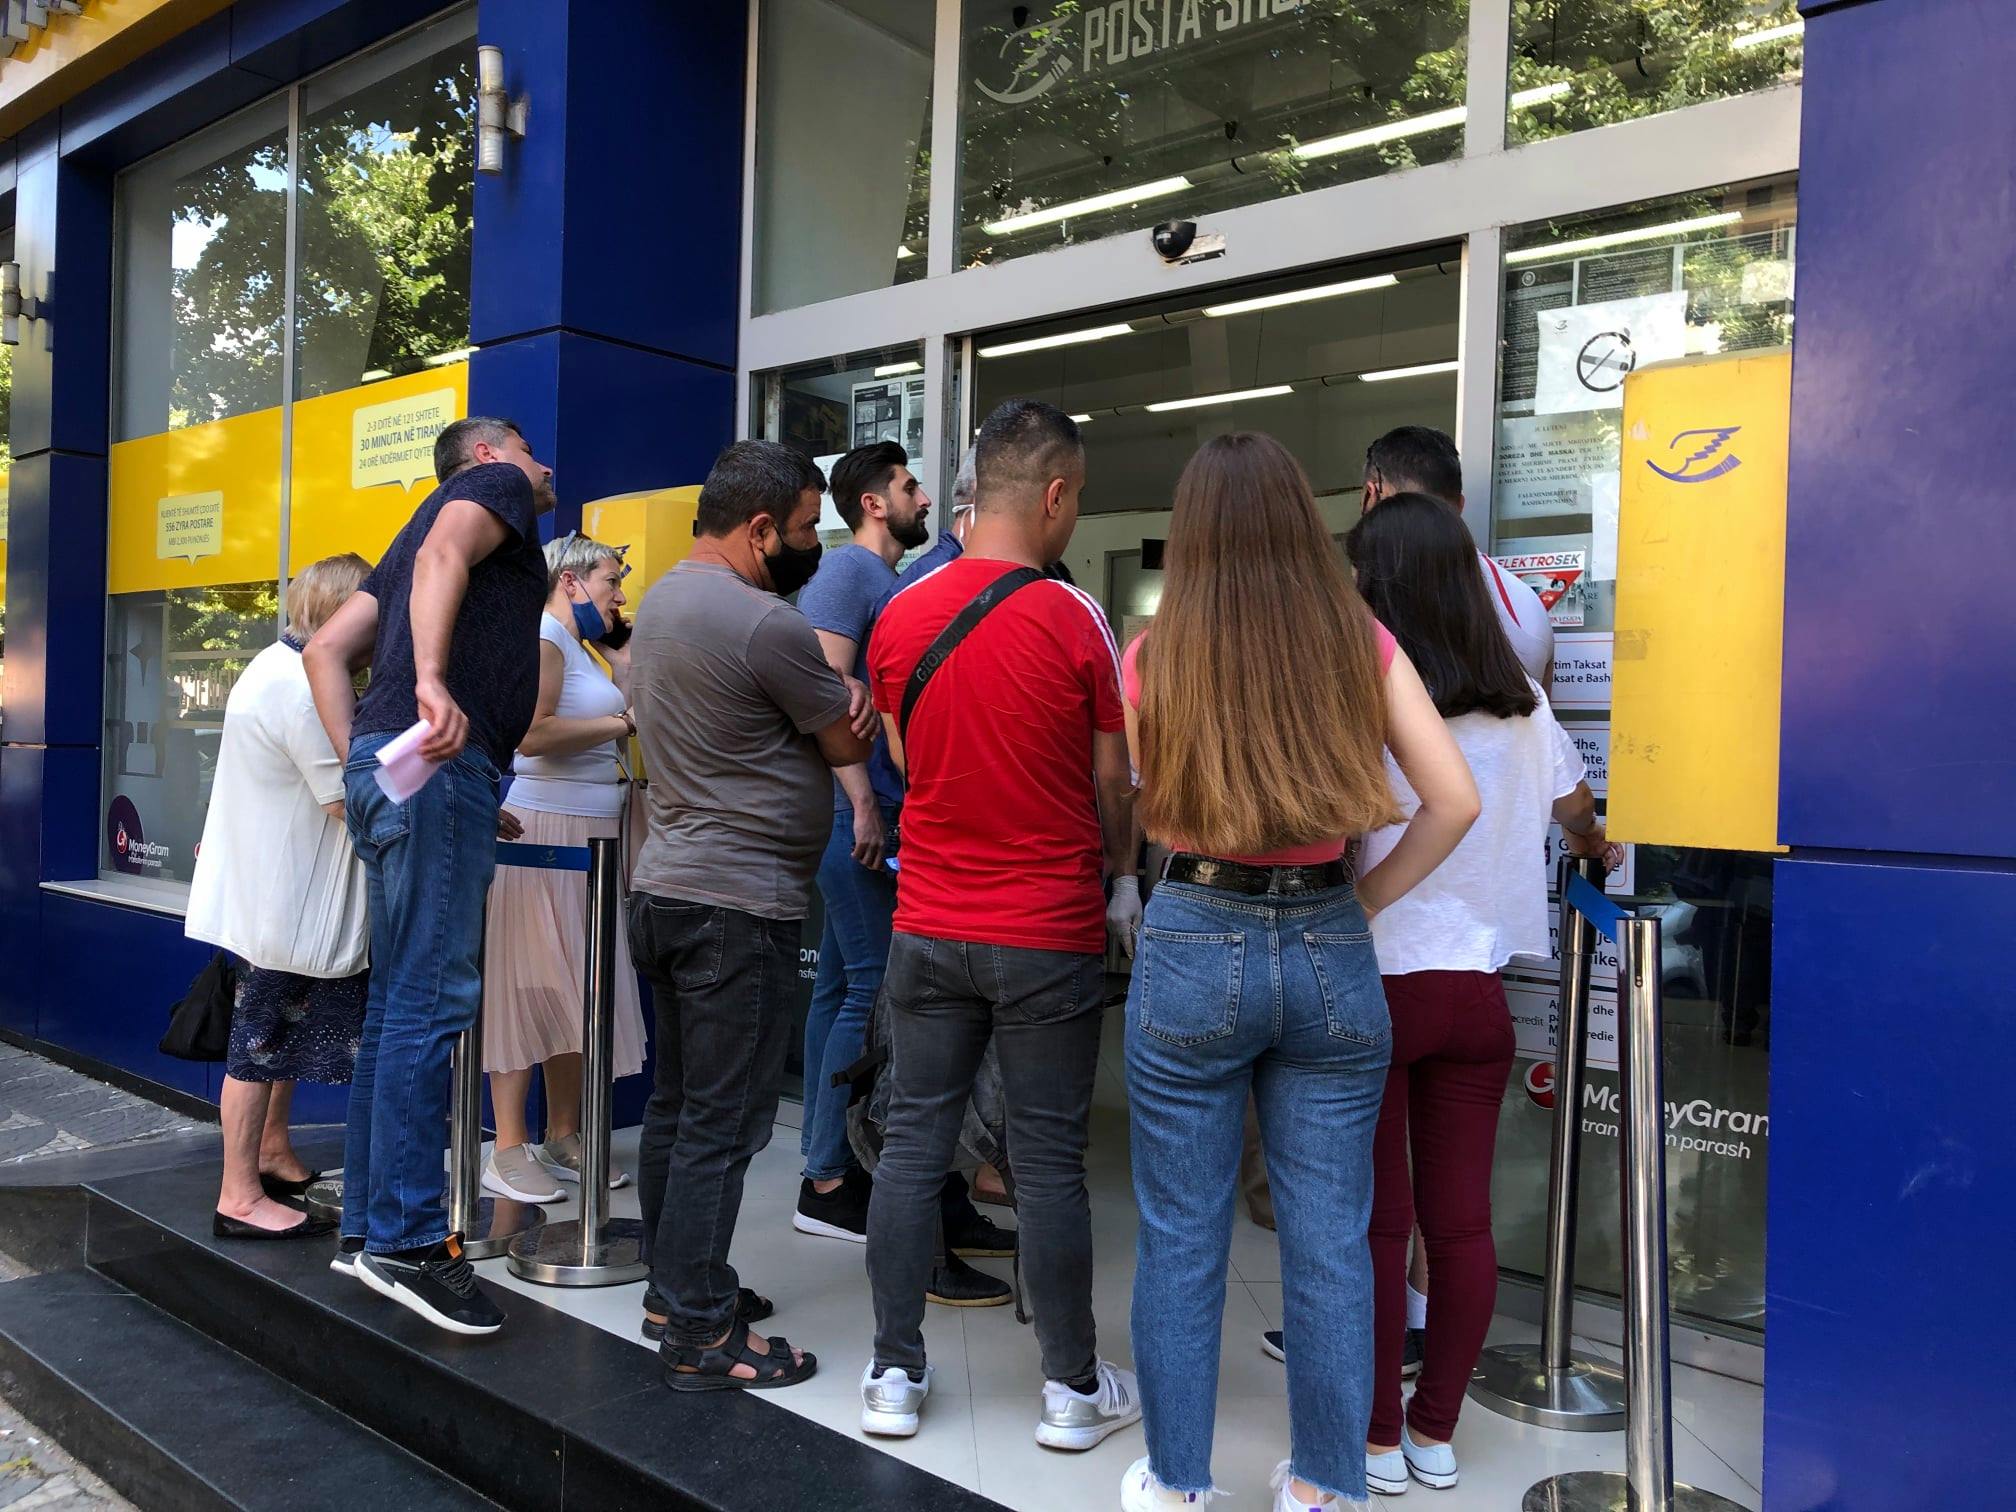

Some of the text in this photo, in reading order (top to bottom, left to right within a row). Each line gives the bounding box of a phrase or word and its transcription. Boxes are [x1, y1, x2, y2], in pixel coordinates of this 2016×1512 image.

[1083, 0, 1201, 72] POSTA
[360, 438, 370, 451] 30
[371, 431, 402, 449] MINUTA
[1573, 659, 1606, 670] Taksat
[1553, 672, 1611, 683] ksat e Bash
[1584, 768, 1608, 779] rsit
[128, 838, 169, 856] MoneyGram
[1593, 1004, 1615, 1016] dhe
[1680, 1132, 1750, 1159] parash
